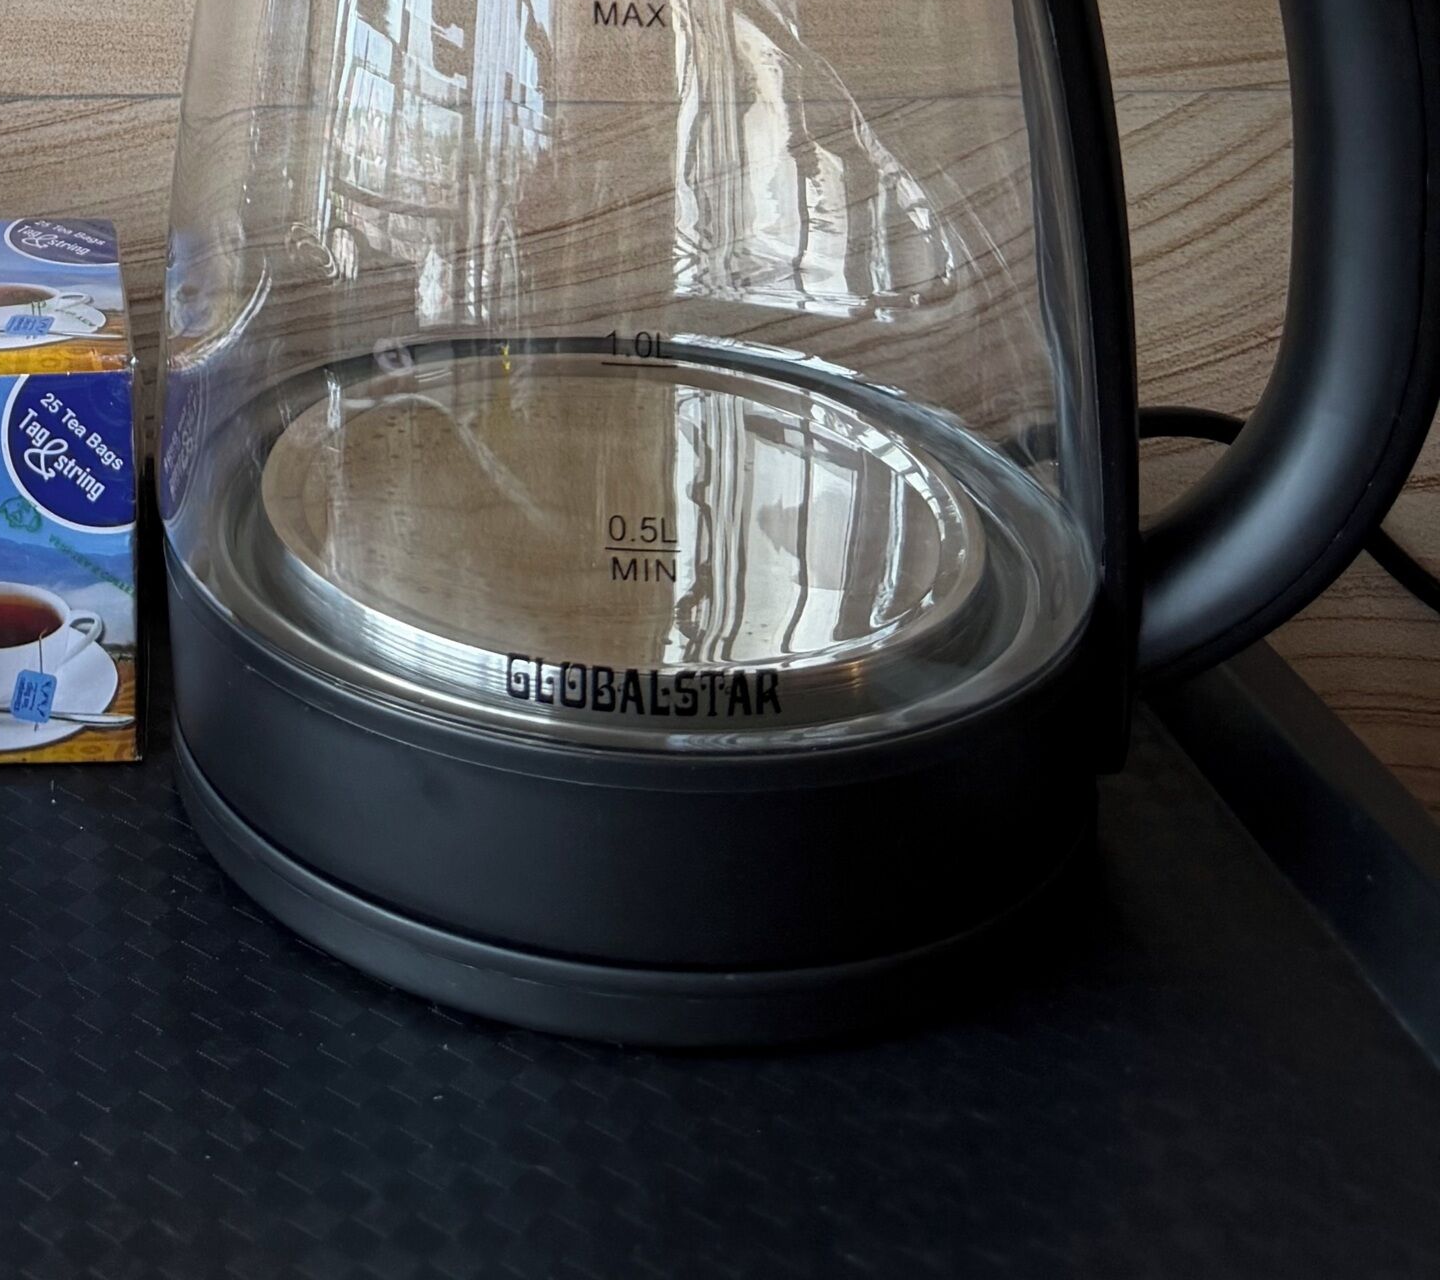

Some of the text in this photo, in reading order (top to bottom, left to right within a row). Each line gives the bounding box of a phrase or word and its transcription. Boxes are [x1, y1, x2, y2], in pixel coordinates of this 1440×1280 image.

[594, 1, 666, 28] MAX
[605, 330, 672, 358] 1.0L
[40, 392, 124, 472] 25 Tea Bags
[608, 514, 677, 543] 0.5L
[612, 556, 676, 582] MIN
[506, 652, 782, 717] GLOBALSTAR
